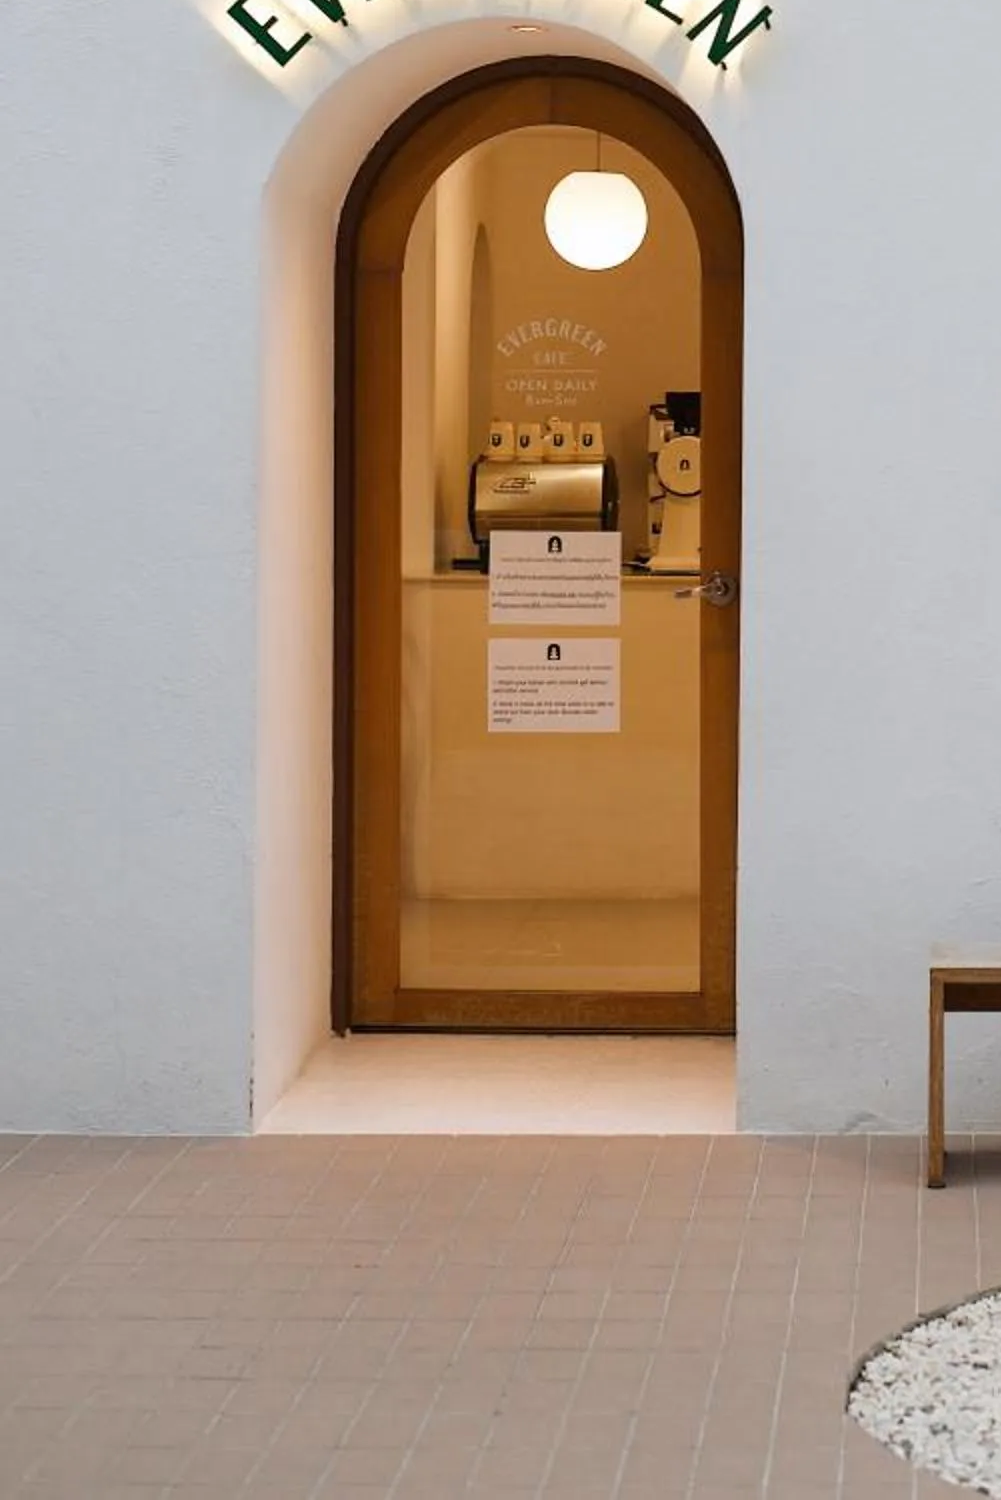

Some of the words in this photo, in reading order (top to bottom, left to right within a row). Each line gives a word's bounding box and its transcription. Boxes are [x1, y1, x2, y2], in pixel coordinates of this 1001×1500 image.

[497, 317, 607, 357] EVERGREEN
[505, 378, 547, 392] OPEN
[553, 378, 598, 392] DAILY
